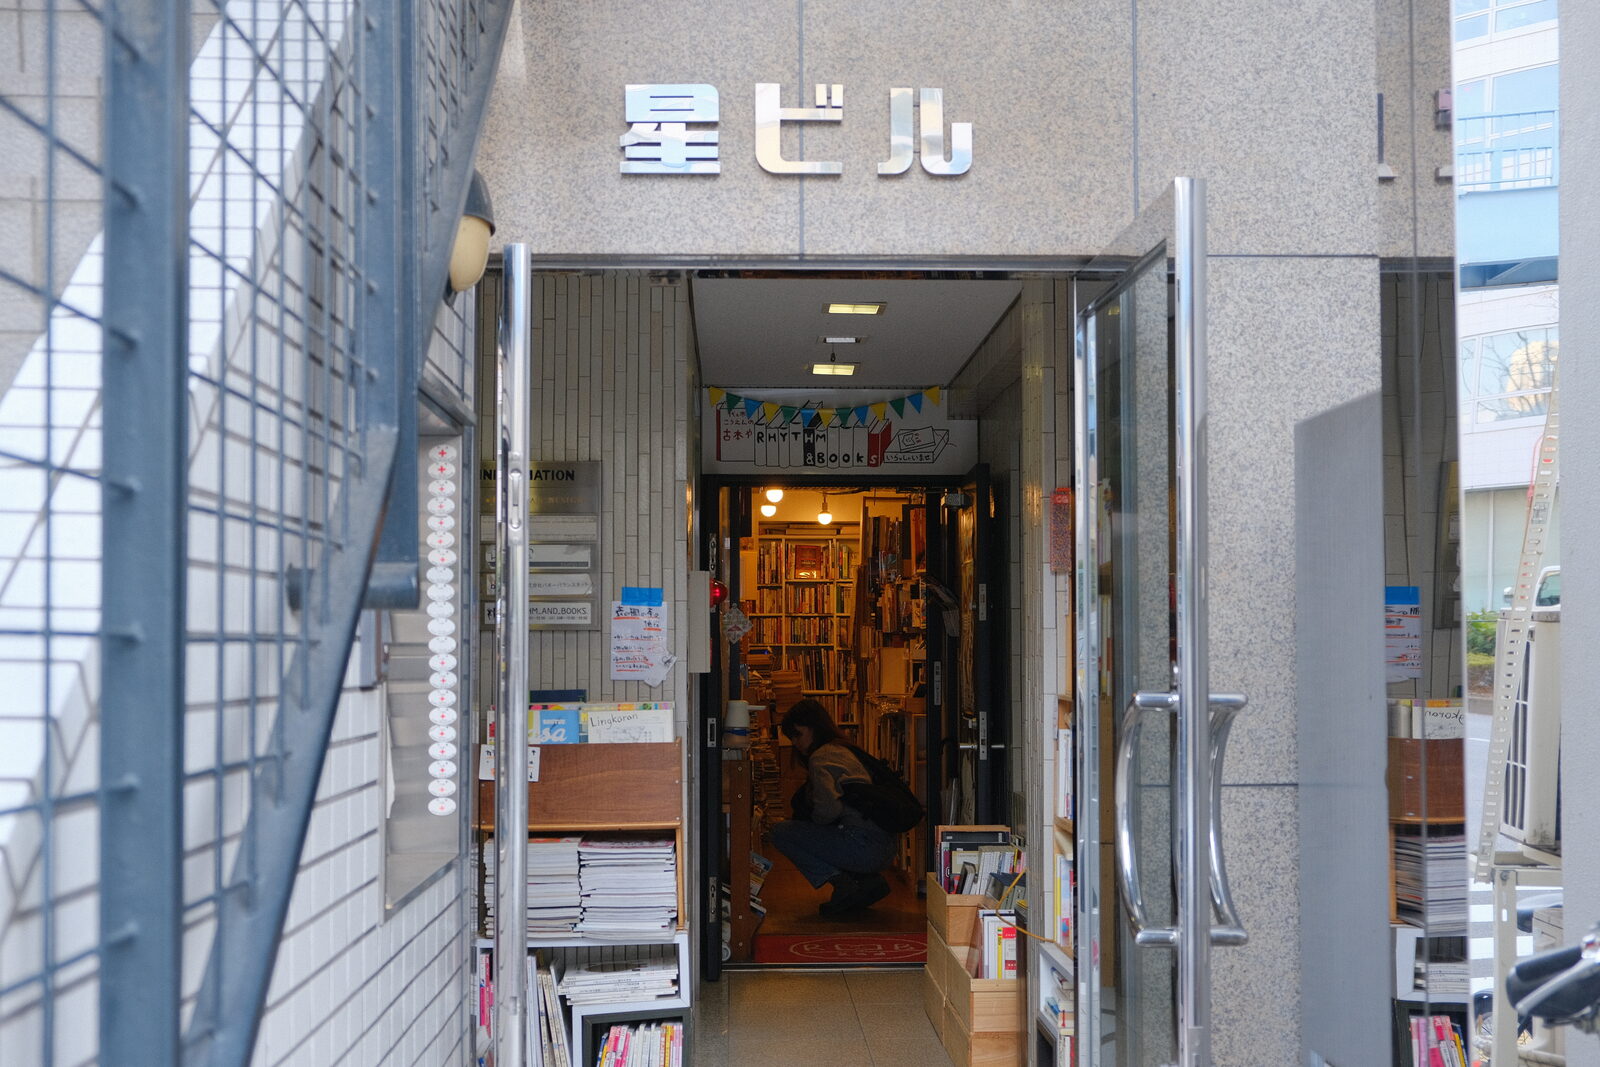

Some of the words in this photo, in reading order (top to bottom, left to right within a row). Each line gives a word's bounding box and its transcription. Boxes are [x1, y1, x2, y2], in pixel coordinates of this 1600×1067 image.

[619, 82, 973, 175] 星ビル
[722, 428, 753, 441] 古本や
[756, 431, 826, 444] RHYTHM
[480, 469, 575, 481] INATION
